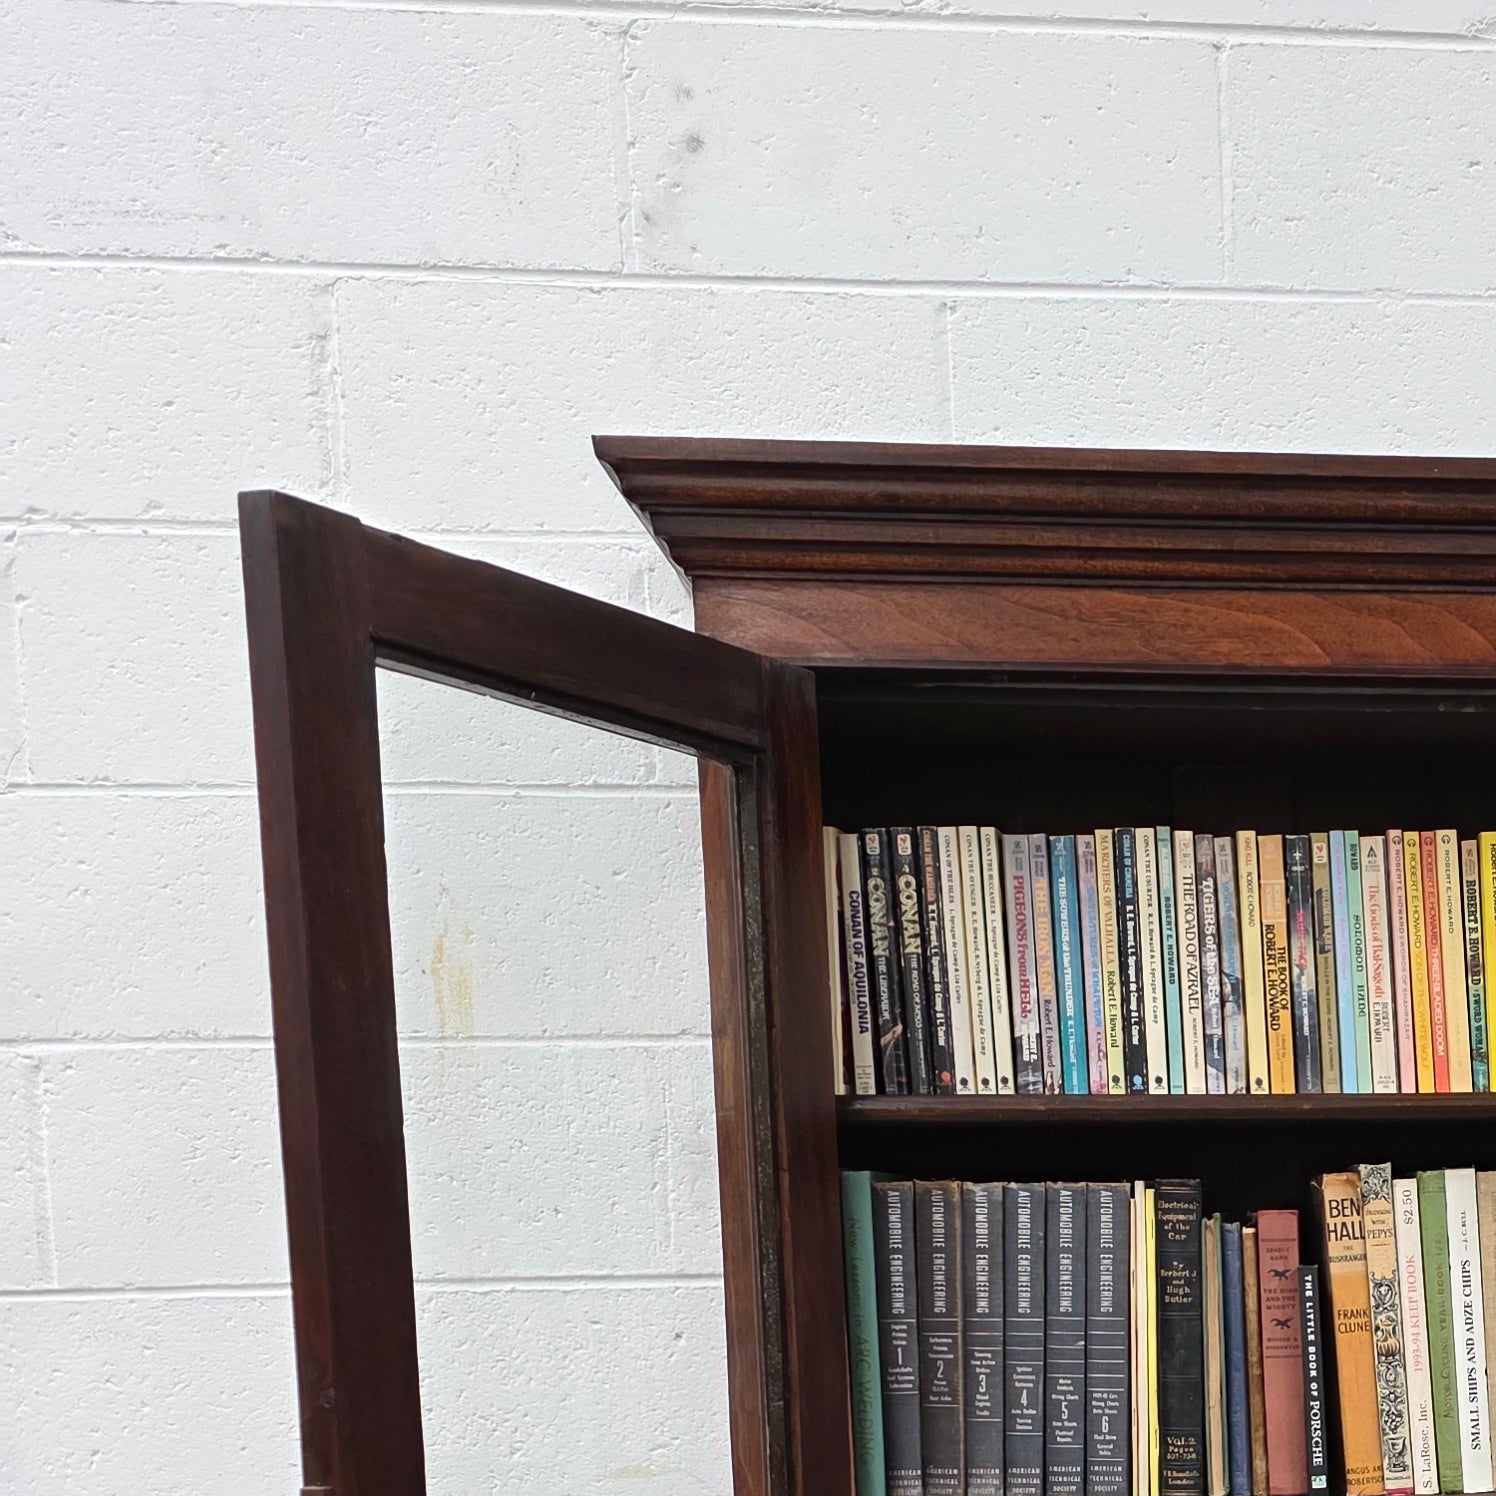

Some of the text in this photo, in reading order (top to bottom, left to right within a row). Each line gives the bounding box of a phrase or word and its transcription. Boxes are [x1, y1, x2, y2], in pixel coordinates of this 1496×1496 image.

[1100, 835, 1115, 965] MARCHERS OF VALHALLA
[1013, 875, 1031, 1019] PIGEONS from HELL
[1182, 874, 1200, 1014] THE ROAD OF AZRAEL
[1266, 924, 1278, 967] ROBERT
[849, 890, 869, 1034] CONAN OF AQUILONIA
[1277, 946, 1288, 1011] THE BOOK OF
[1106, 970, 1118, 1003] Robert
[1268, 979, 1281, 1031] HOWARD
[1108, 1013, 1120, 1048] Howard
[1330, 1198, 1361, 1218] BEN
[1404, 1189, 1413, 1225] $2.50
[1327, 1221, 1364, 1242] HALL
[1367, 1228, 1393, 1239] PEPYS
[1100, 1190, 1113, 1313] AUTOMOBILE ENGINEERING
[1338, 1309, 1369, 1320] FRANK
[1338, 1322, 1370, 1334] CLUNE
[936, 1361, 944, 1377] 2
[1304, 1274, 1322, 1467] THE LITTLE BOOK OF PORSCHE
[1460, 1259, 1481, 1450] SMALL SHIPS AND ADZE CHIPS
[979, 1375, 986, 1393] 3
[1020, 1389, 1027, 1406] 4
[1061, 1402, 1068, 1419] 5
[1101, 1416, 1108, 1432] 6
[1418, 1400, 1427, 1422] Inc.
[1423, 1475, 1432, 1489] S.
